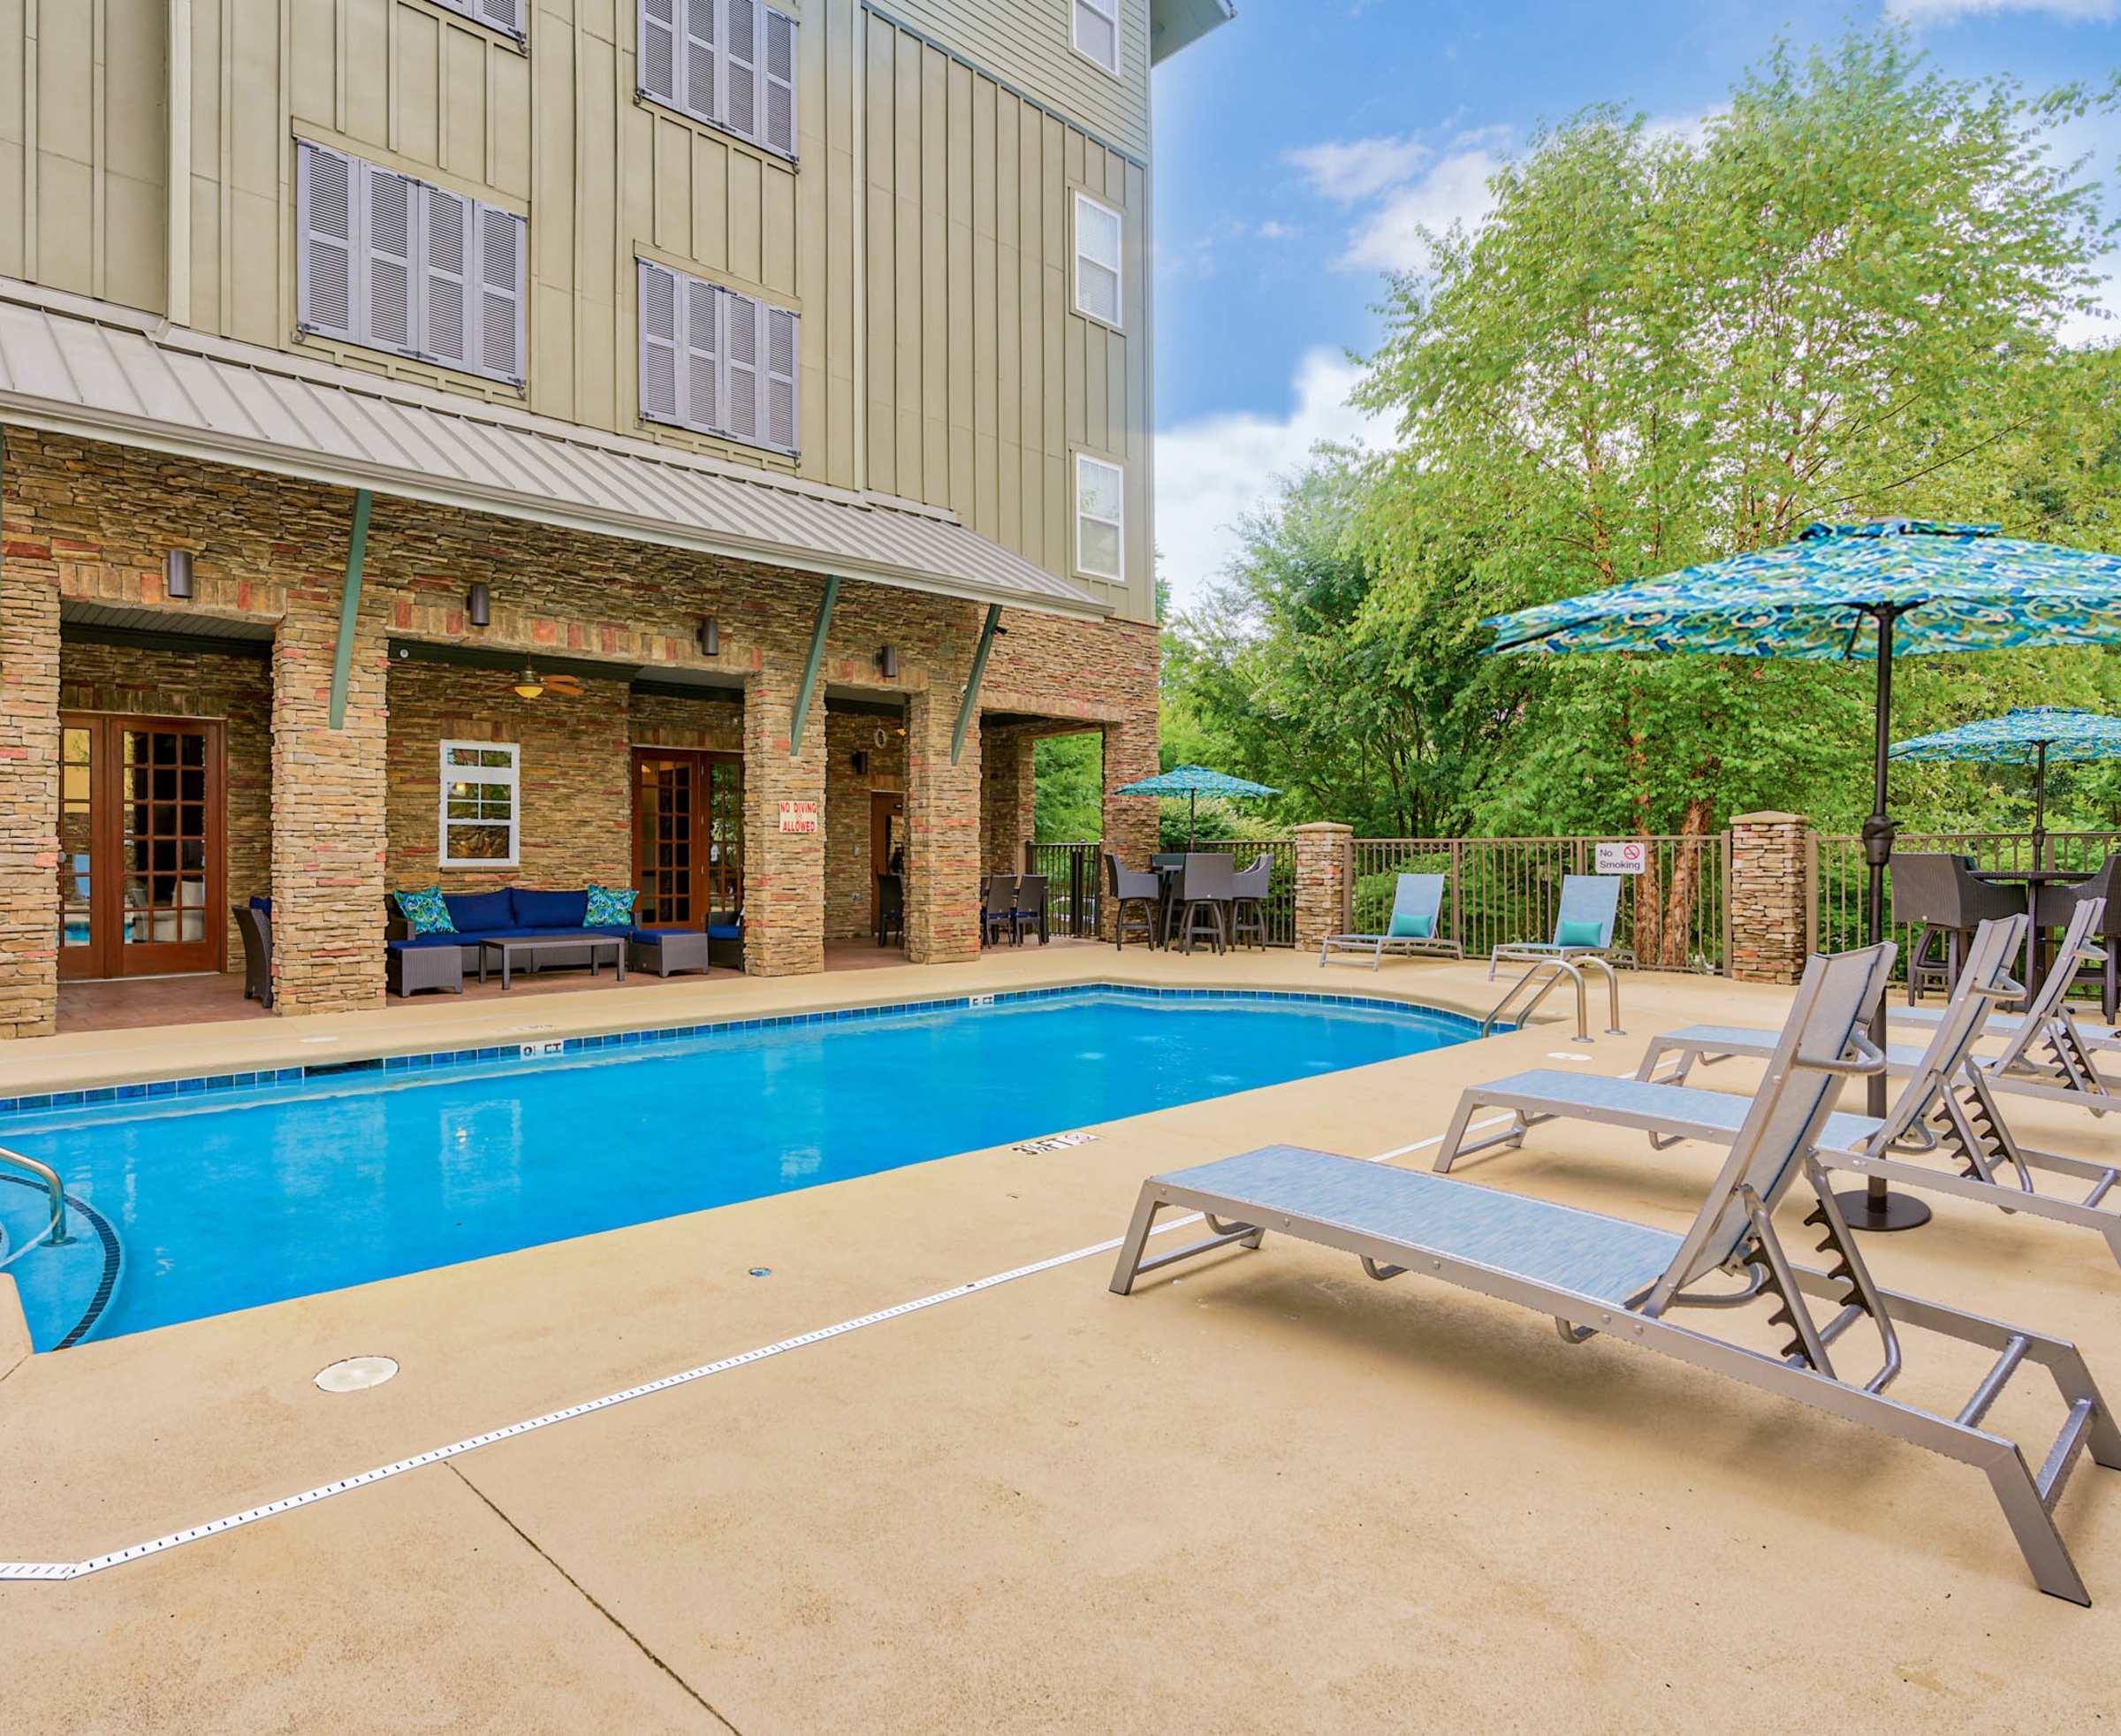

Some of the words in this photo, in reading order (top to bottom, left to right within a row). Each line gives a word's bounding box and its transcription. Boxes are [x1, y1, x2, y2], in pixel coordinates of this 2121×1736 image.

[779, 802, 790, 813] NO
[794, 802, 817, 813] DIVING
[782, 820, 815, 832] ALLOWED
[1600, 849, 1613, 857] No
[1600, 860, 1641, 871] Smoking
